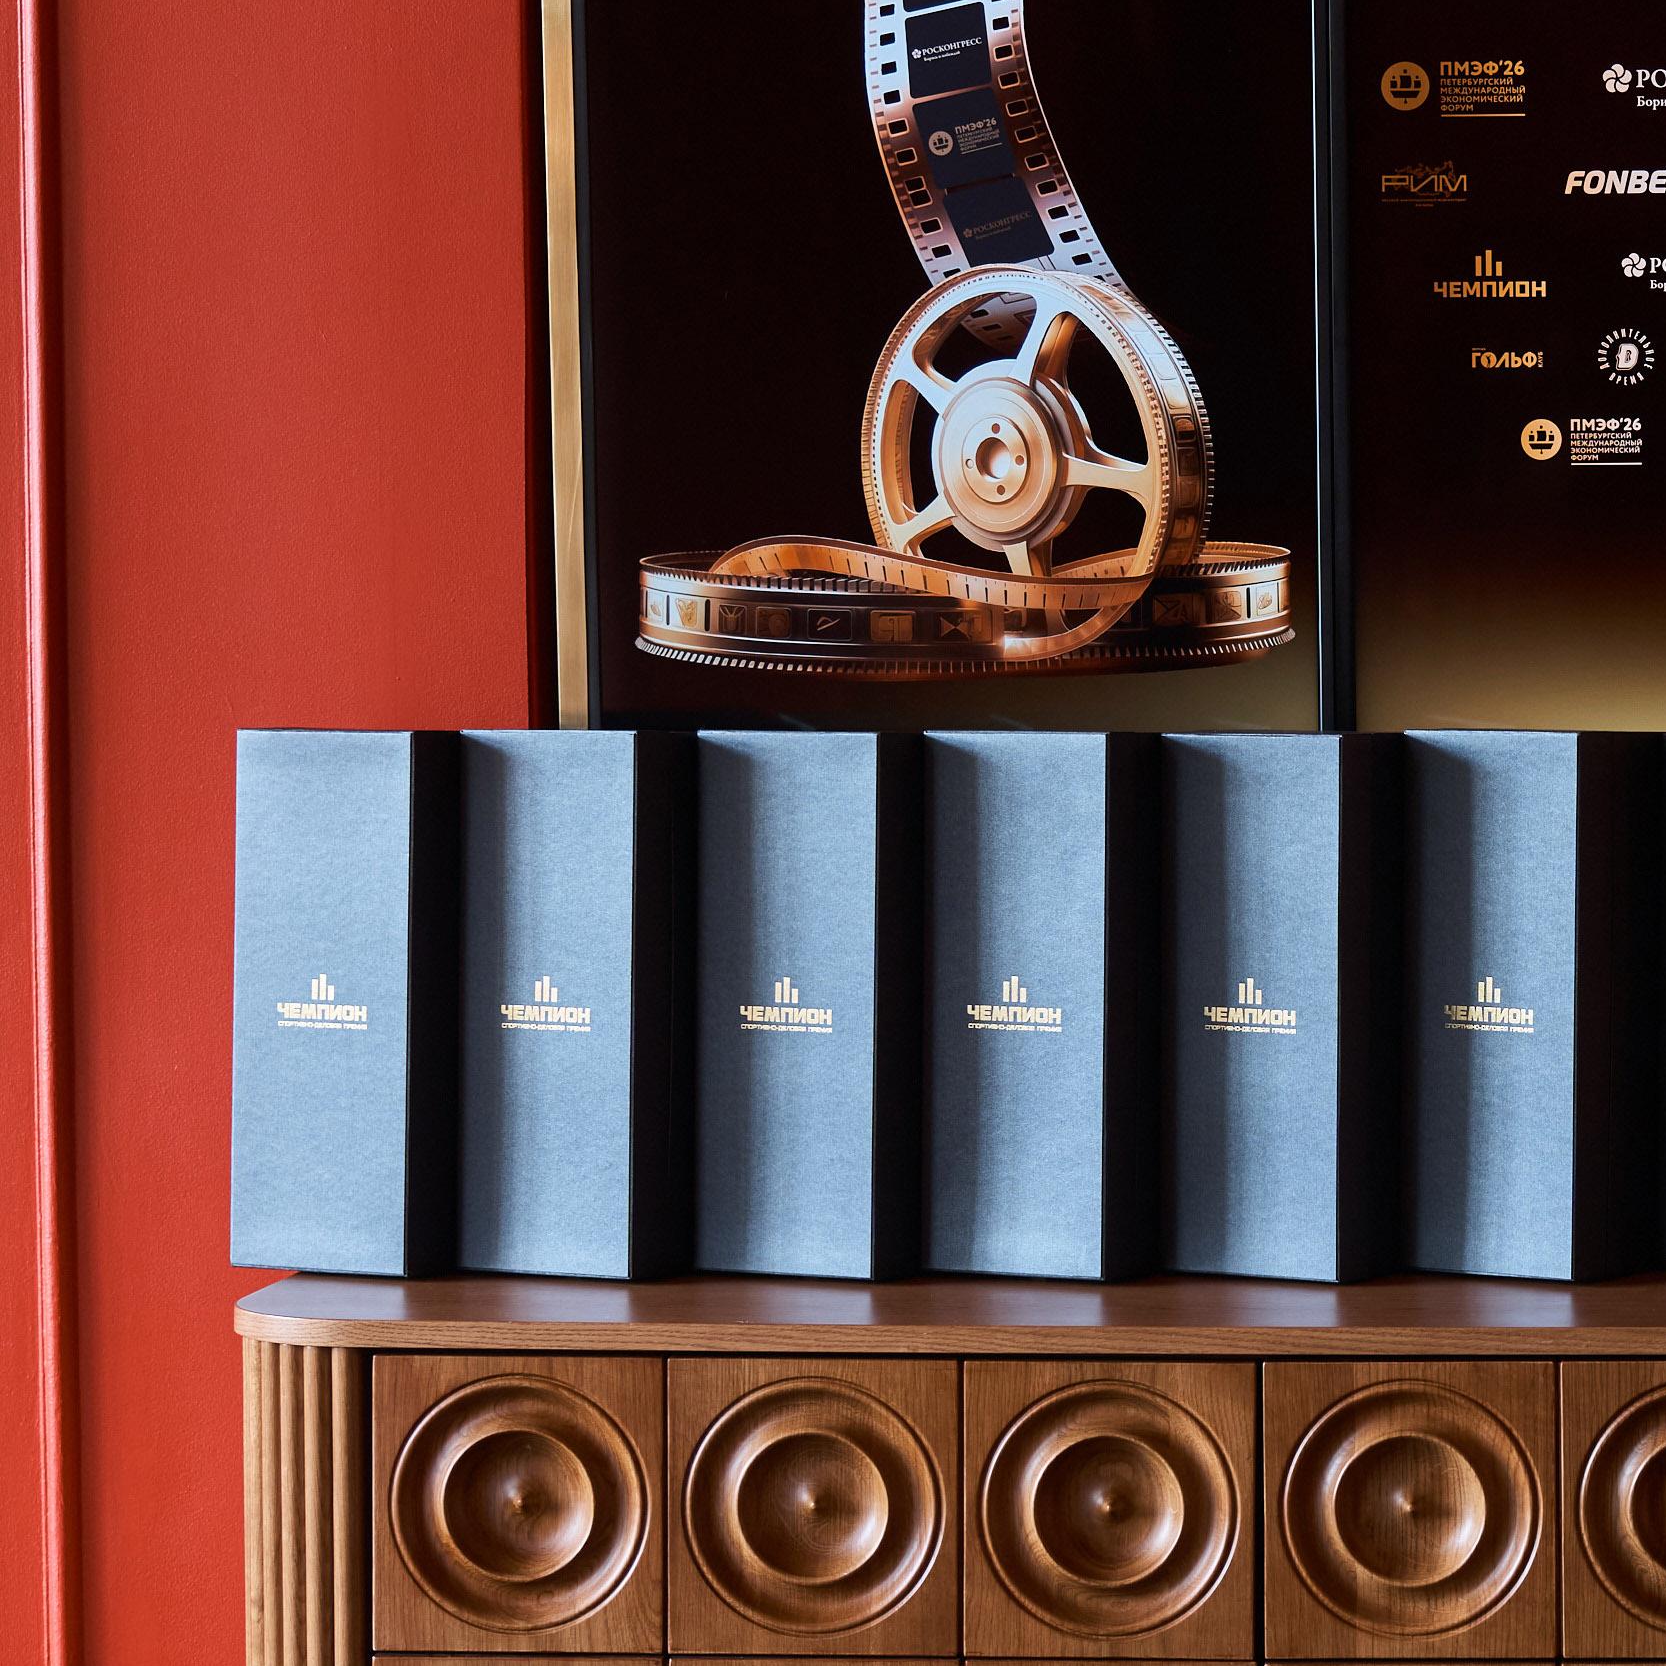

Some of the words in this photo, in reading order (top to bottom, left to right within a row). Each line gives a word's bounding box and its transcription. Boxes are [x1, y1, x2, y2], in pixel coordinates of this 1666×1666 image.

[922, 37, 983, 56] РОСКОНГРЕСС
[1440, 59, 1525, 76] ПМЭФ'26
[1440, 77, 1514, 86] ПЕТЕРБУРГСКИЙ
[1440, 85, 1526, 95] МЕЖДУНАРОДНЫЙ
[1440, 94, 1524, 103] ЭКОНОМИЧЕСКИЙ
[1440, 104, 1474, 112] ФОРУМ
[1433, 280, 1547, 298] ЧЕМПИОН
[1471, 351, 1538, 368] ГОЛЬФ
[1570, 418, 1642, 431] ПМЭФ'26
[1570, 432, 1632, 440] ПЕТЕРБУРГСКИЙ
[1570, 439, 1643, 447] МЕЖДУНАРОДНЫЙ
[1570, 446, 1641, 454] ЭКОНОМИЧЕСКИЙ
[277, 1002, 368, 1021] ЧЕМПИОН
[501, 1004, 591, 1023] ЧЕМПИОН
[740, 1005, 833, 1025] ЧЕМПИОН
[967, 1005, 1062, 1024] ЧЕМПИОН
[1203, 1006, 1296, 1026] ЧЕМПИОН
[1444, 1005, 1534, 1025] ЧЕМПИОН
